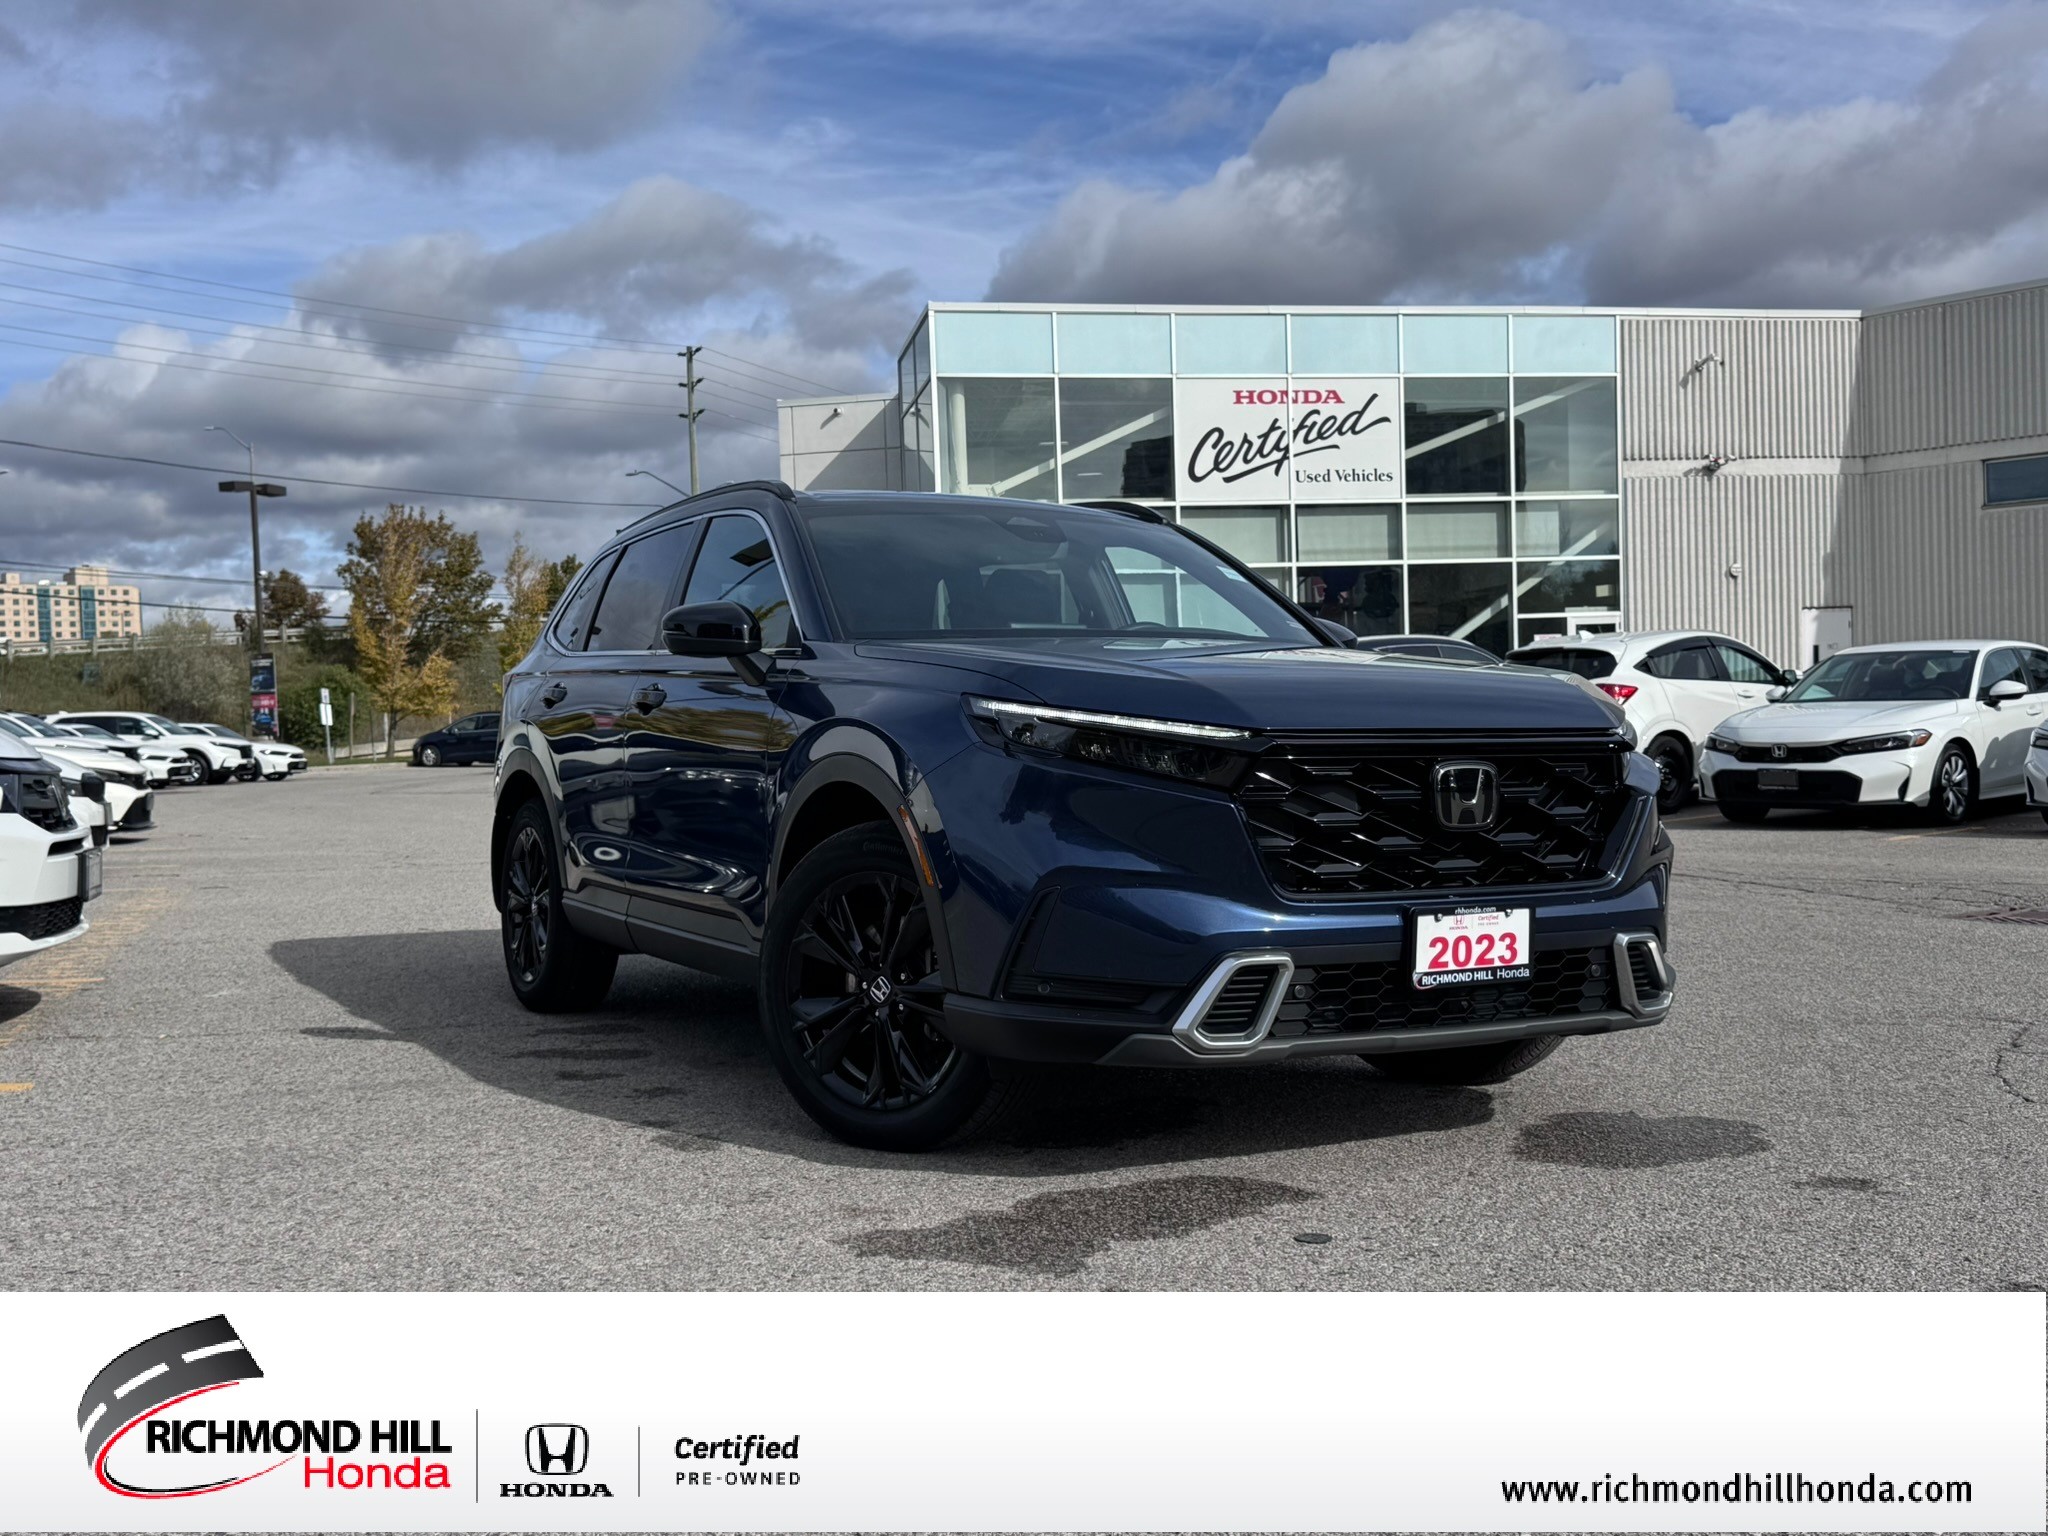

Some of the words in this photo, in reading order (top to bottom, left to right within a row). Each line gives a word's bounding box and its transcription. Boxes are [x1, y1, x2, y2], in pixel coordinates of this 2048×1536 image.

[1233, 389, 1345, 405] HONDA
[1188, 392, 1392, 483] Certified
[1296, 469, 1331, 483] Used
[1335, 468, 1393, 483] Vehicles
[1455, 906, 1497, 915] rhhonda.com
[1428, 932, 1518, 970] 2023
[1422, 972, 1473, 986] RICHMOND
[1474, 969, 1494, 981] HILL
[1497, 967, 1530, 979] Honda
